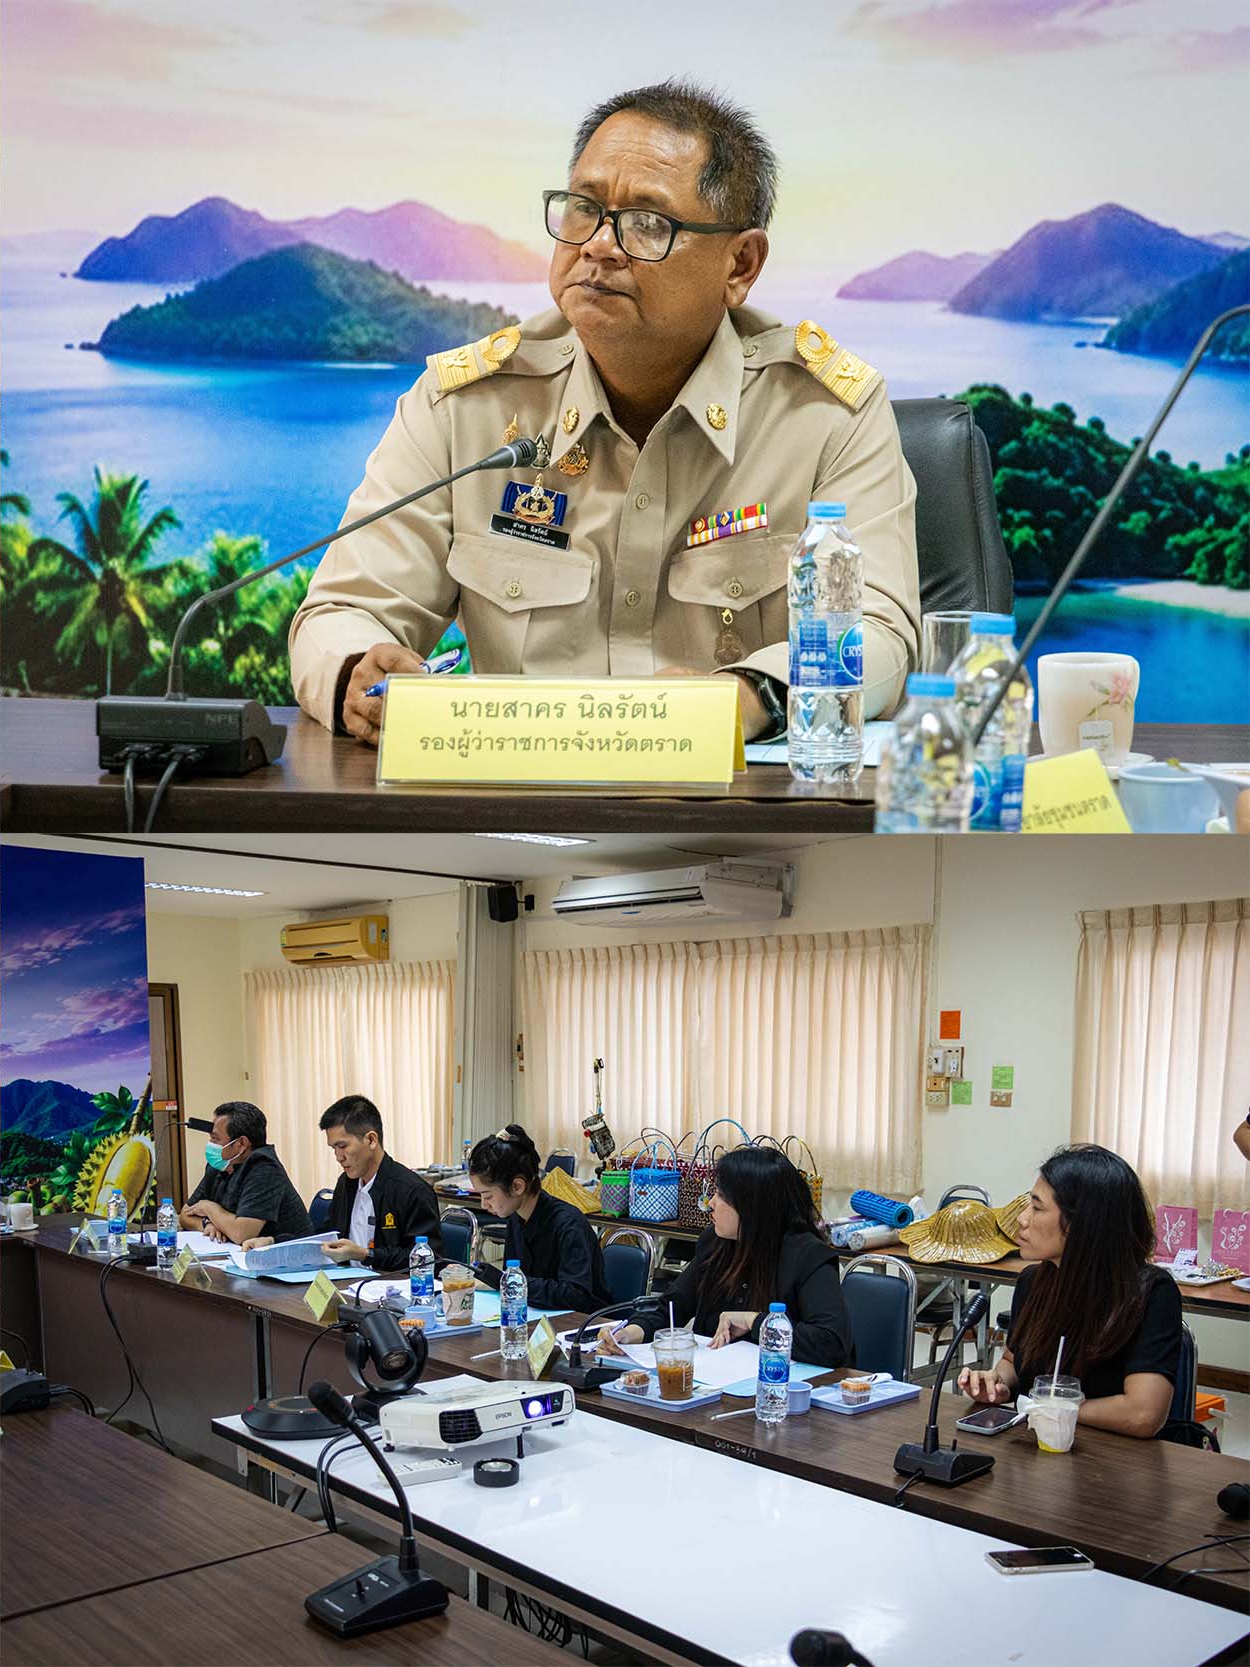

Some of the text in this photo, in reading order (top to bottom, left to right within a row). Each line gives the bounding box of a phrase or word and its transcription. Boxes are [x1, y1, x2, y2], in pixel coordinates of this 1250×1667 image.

[450, 692, 668, 719] นายสาคร นิลรัตน์
[205, 713, 239, 726] NPE
[419, 728, 693, 758] รองผู้ว่าราชการจังหวัดตราด
[495, 1411, 512, 1420] EPSON
